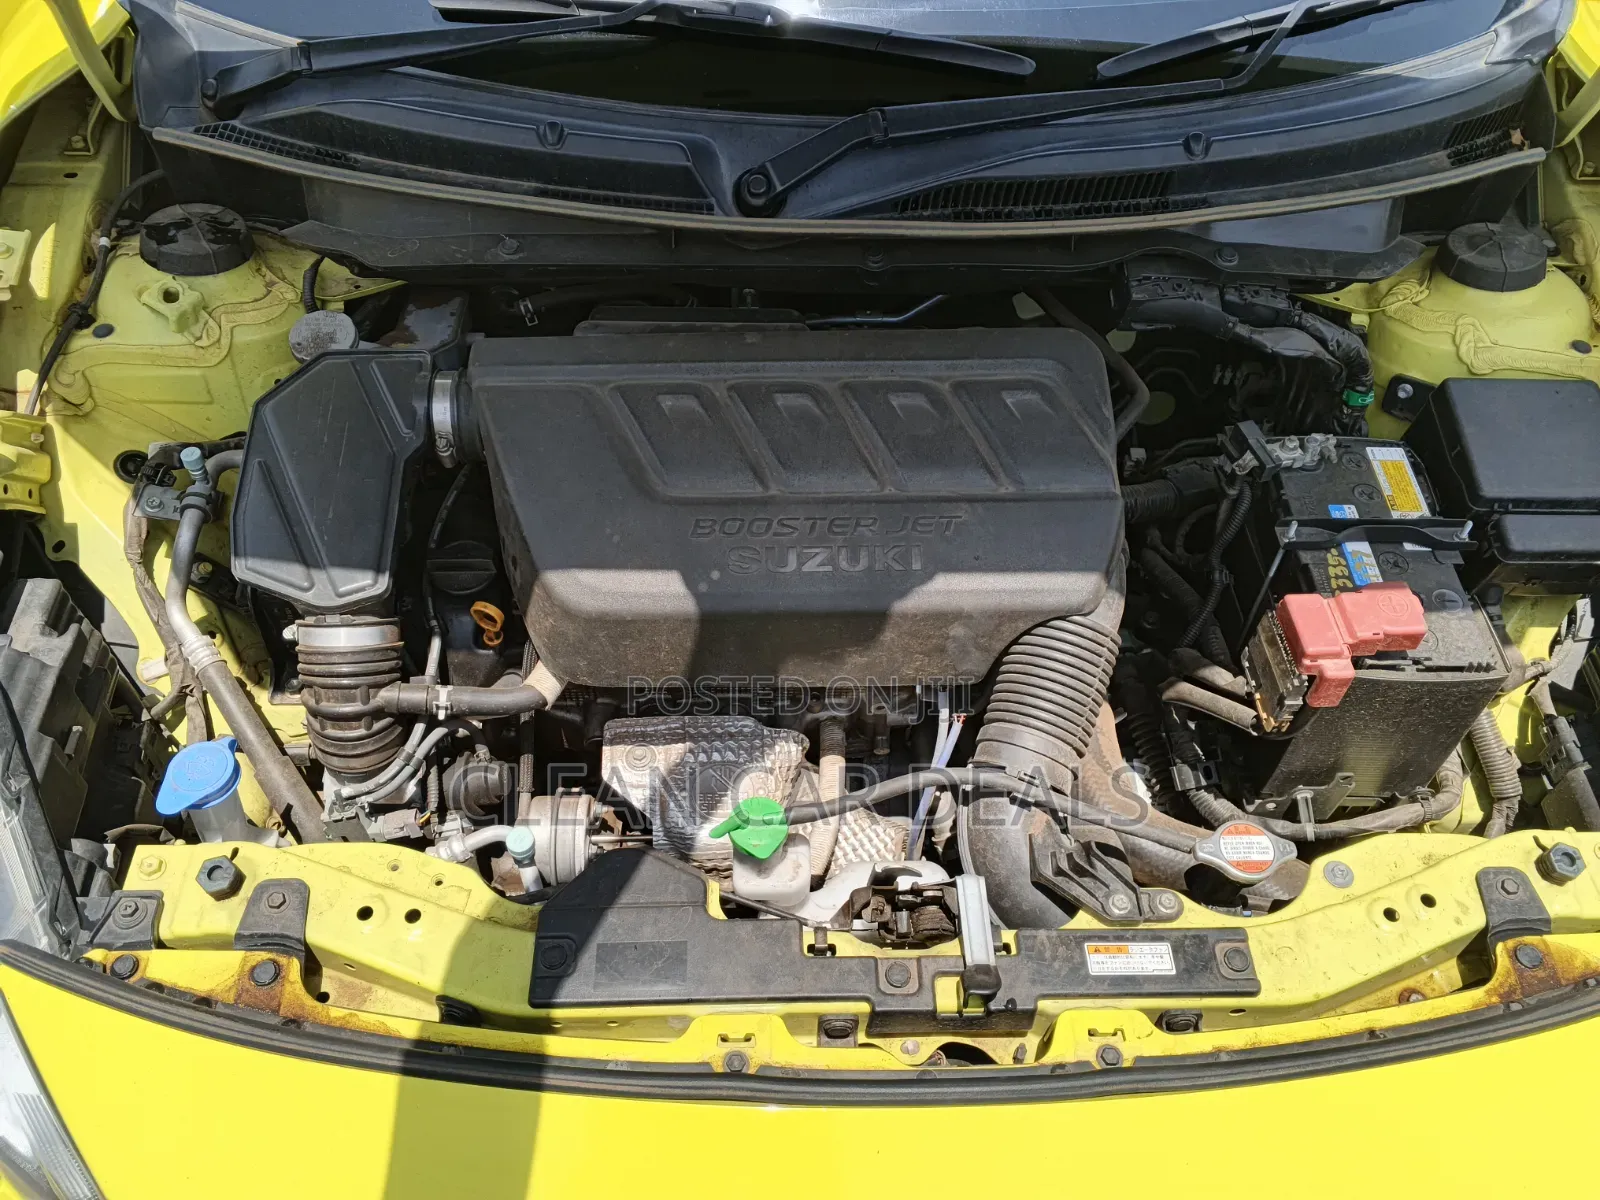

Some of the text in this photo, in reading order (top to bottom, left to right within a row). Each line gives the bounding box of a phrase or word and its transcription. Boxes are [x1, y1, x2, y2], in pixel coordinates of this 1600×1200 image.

[688, 514, 965, 539] BOOSTER JET
[726, 543, 923, 574] SUZUKI
